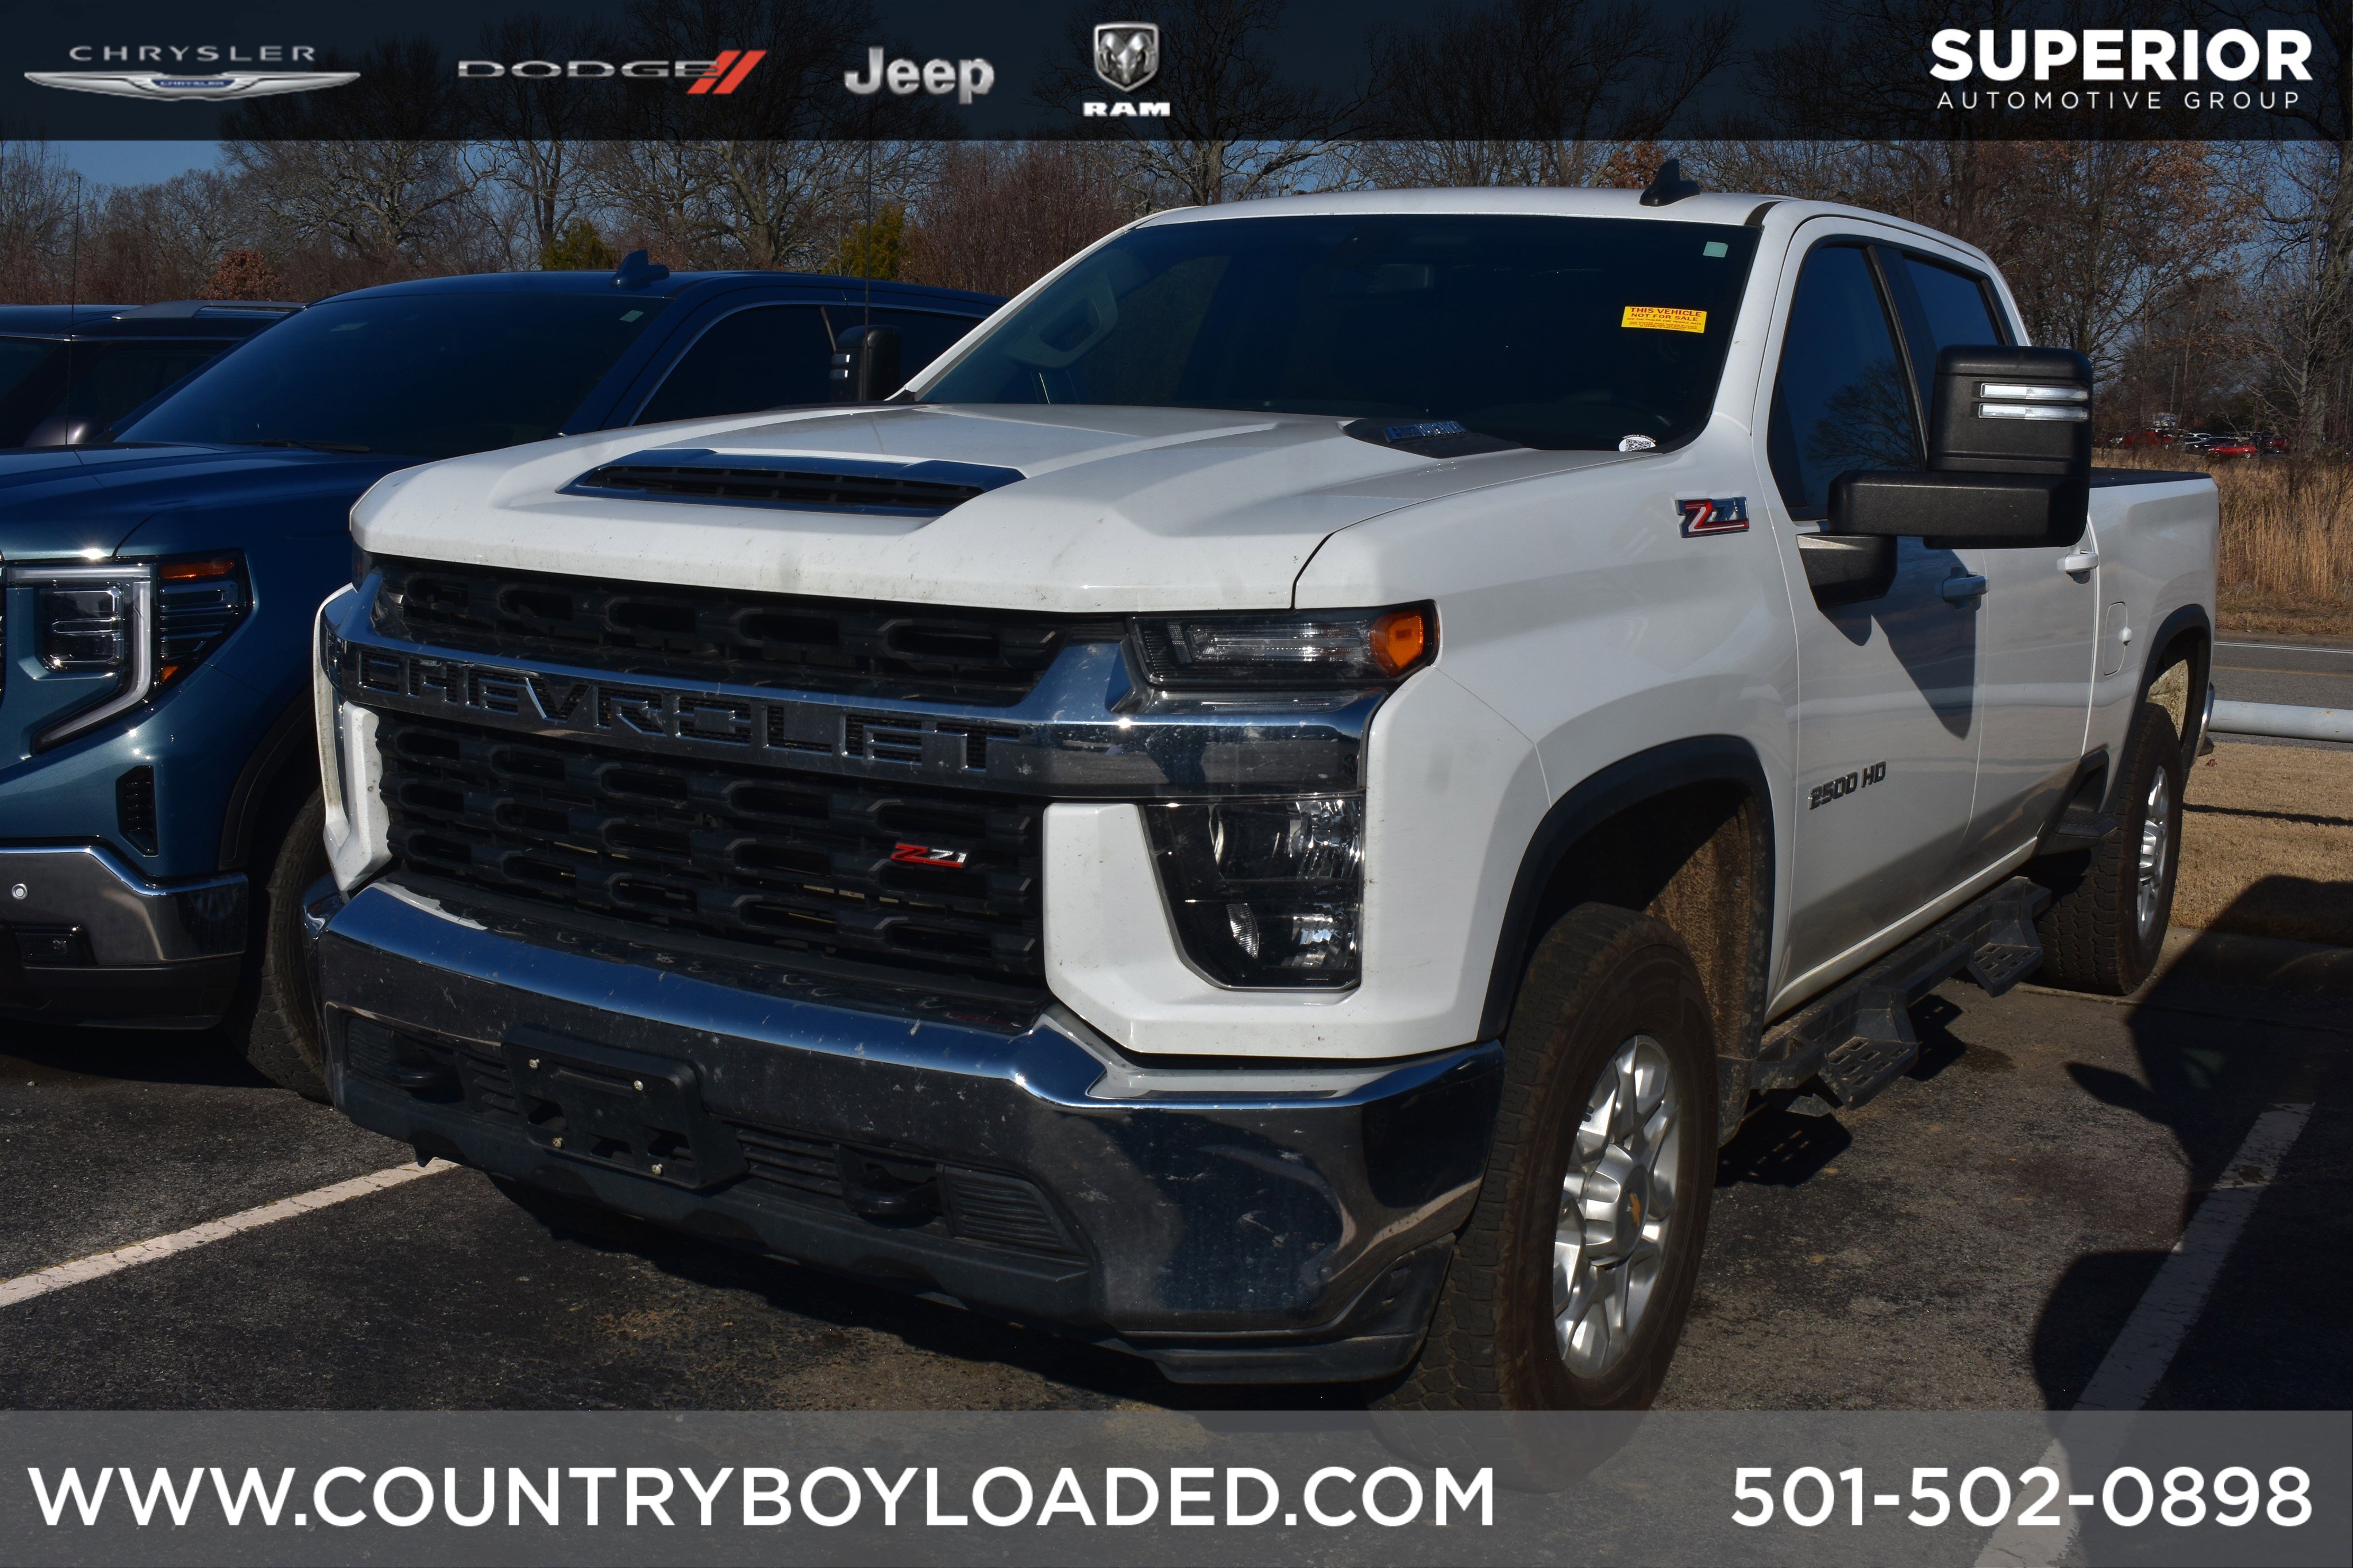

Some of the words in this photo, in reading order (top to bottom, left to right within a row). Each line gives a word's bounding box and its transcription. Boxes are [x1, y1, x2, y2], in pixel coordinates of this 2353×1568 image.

[1657, 308, 1702, 317] VEHICLE
[1675, 497, 1750, 538] Z71
[358, 650, 1020, 772] CHEVROLET
[1808, 771, 1858, 810] 2500
[1861, 760, 1887, 788] HD
[891, 843, 969, 868] Z71
